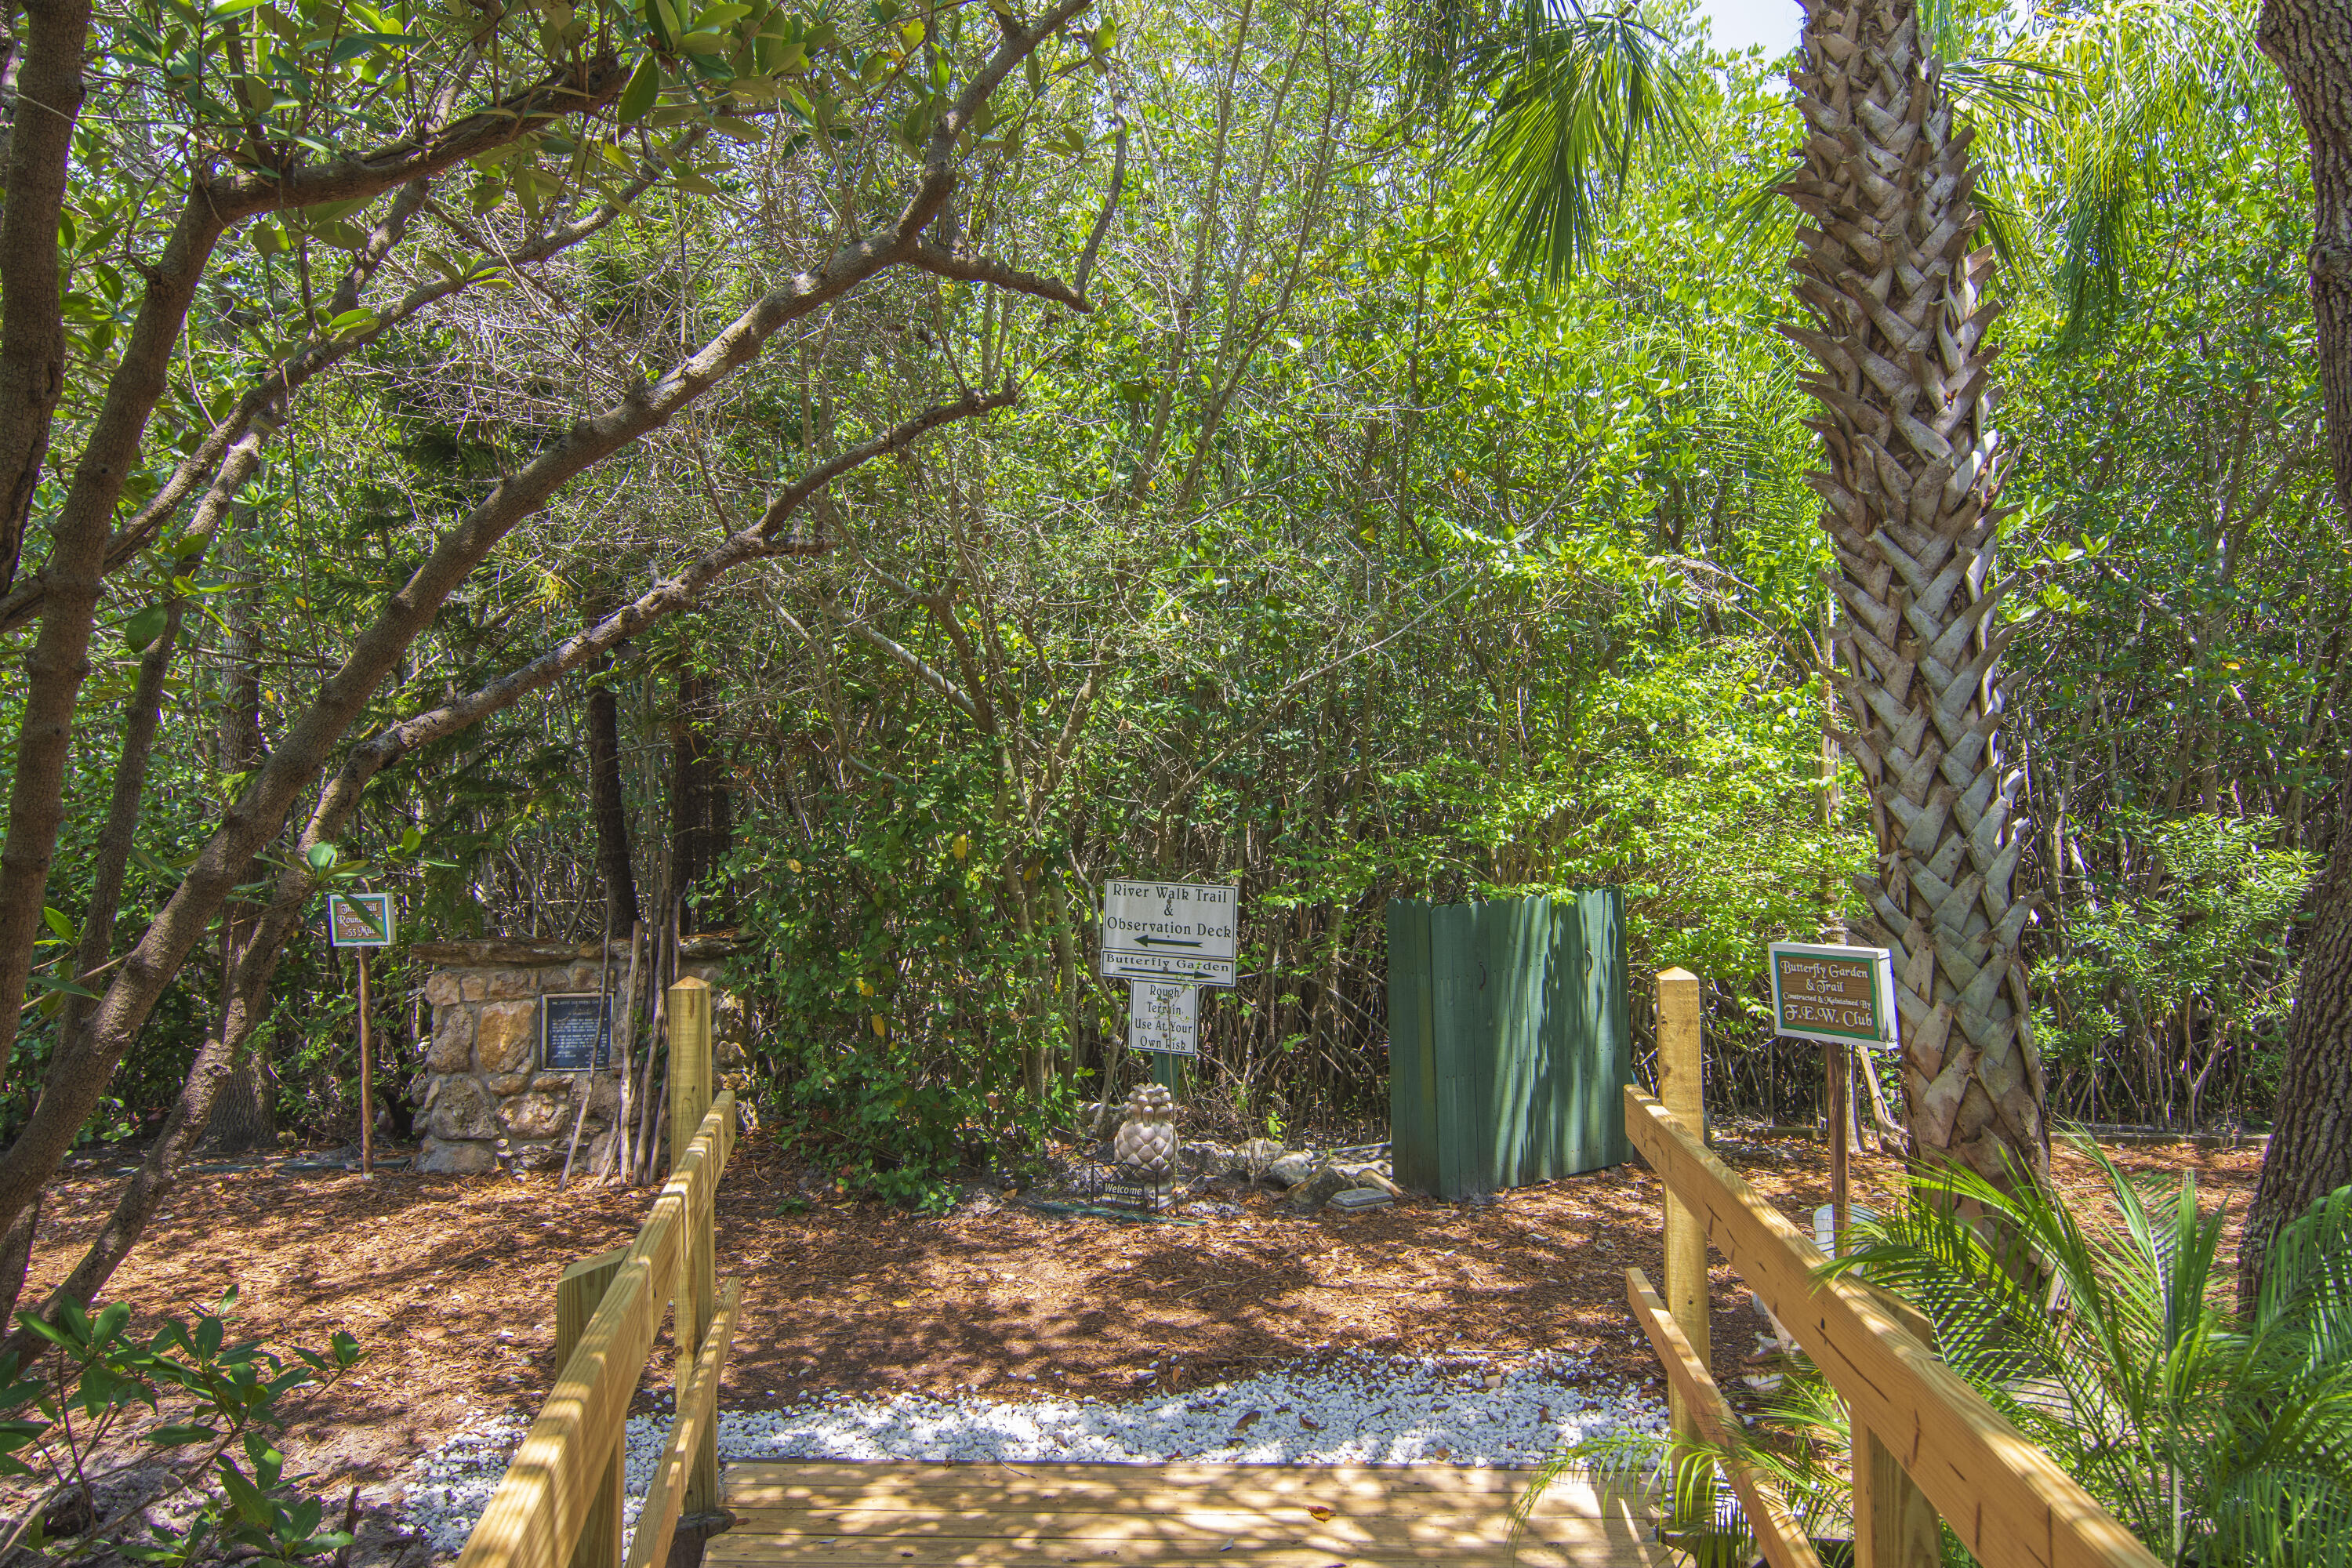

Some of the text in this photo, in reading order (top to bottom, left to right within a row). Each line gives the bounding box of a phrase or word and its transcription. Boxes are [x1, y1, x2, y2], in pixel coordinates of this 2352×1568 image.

[1113, 884, 1227, 903] River Walk Trail
[1163, 903, 1174, 916] &
[1107, 916, 1231, 938] Observation Deck
[1106, 953, 1229, 972] Butterfly Garden
[1780, 960, 1869, 979] Butterfly Garden
[1150, 985, 1179, 1000] Rough
[1806, 978, 1844, 993] & Trail
[1782, 992, 1817, 1002] Constructed
[1824, 996, 1859, 1006] Maintained
[1860, 1000, 1872, 1011] By
[1784, 1004, 1873, 1027] F.E.W. Club
[1135, 1018, 1192, 1033] Use At Your
[1140, 1036, 1186, 1051] Own Risk
[1105, 1182, 1143, 1196] Welcome
